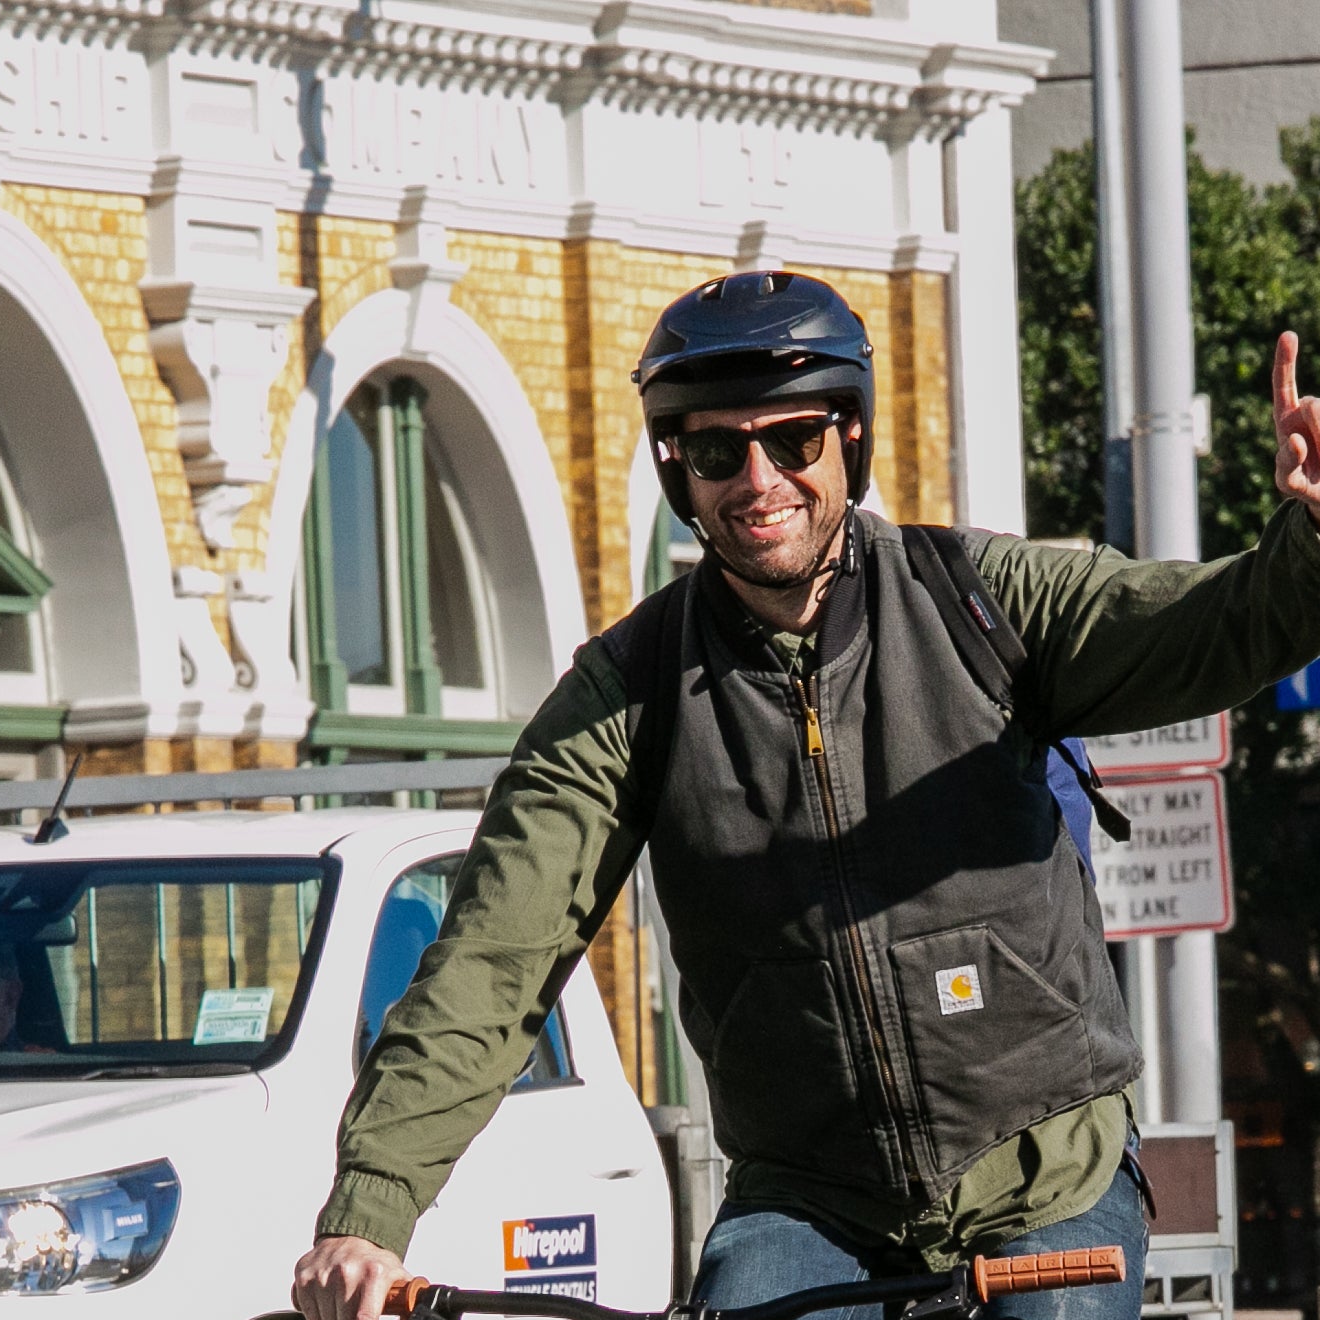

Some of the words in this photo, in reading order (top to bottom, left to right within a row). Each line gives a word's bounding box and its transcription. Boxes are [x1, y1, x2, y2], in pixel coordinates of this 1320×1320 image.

[1165, 790, 1203, 811] MAY
[1126, 823, 1211, 851] TRAIGHT
[1104, 863, 1157, 887] FROM
[1169, 858, 1212, 883] LEFT
[1130, 895, 1181, 922] LANE
[513, 1222, 586, 1266] Hirepool
[992, 1255, 1109, 1273] MARIN
